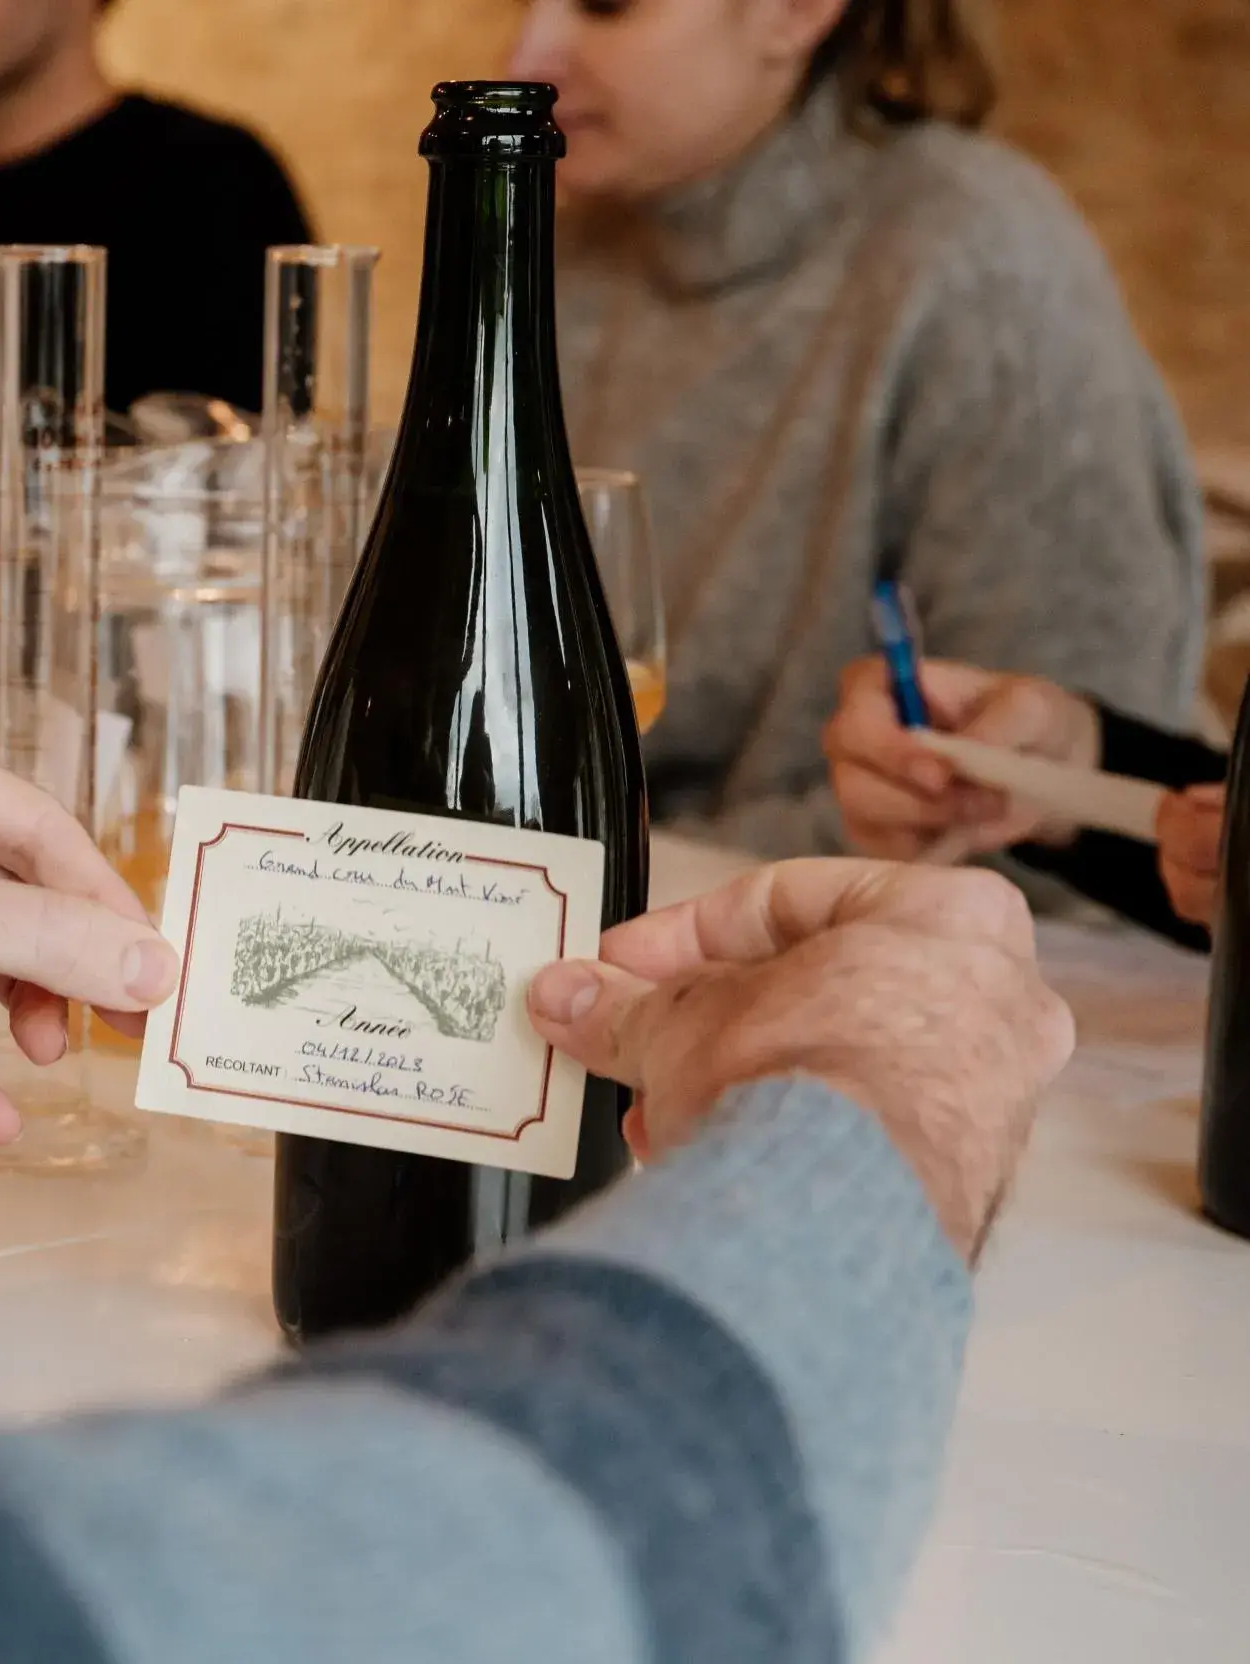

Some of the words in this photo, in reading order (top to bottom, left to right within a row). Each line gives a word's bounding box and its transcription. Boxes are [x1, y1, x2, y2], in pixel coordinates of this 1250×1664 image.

[305, 821, 464, 864] Appellation
[257, 850, 320, 880] Grand
[315, 1004, 413, 1039] Année
